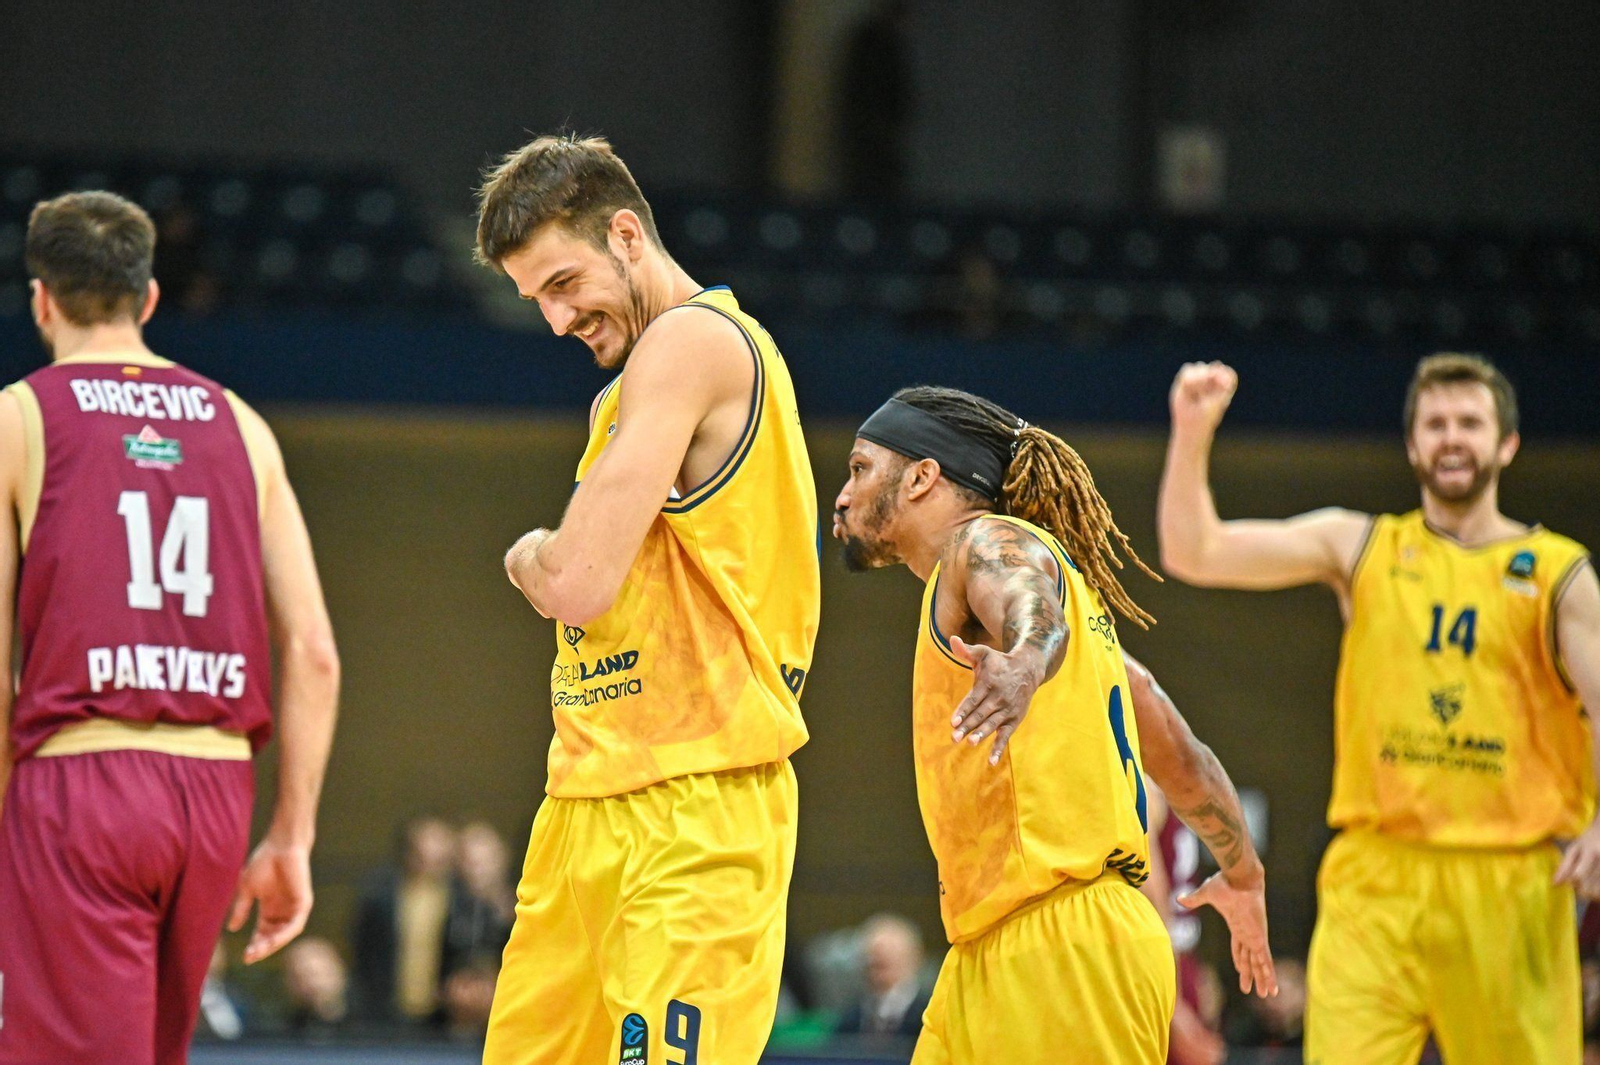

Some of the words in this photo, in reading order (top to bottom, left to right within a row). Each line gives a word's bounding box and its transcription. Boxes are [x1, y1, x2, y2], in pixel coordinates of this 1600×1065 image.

[70, 379, 216, 422] BIRCEVIC
[117, 490, 214, 618] 14
[1424, 604, 1478, 659] 14
[664, 998, 702, 1065] 9
